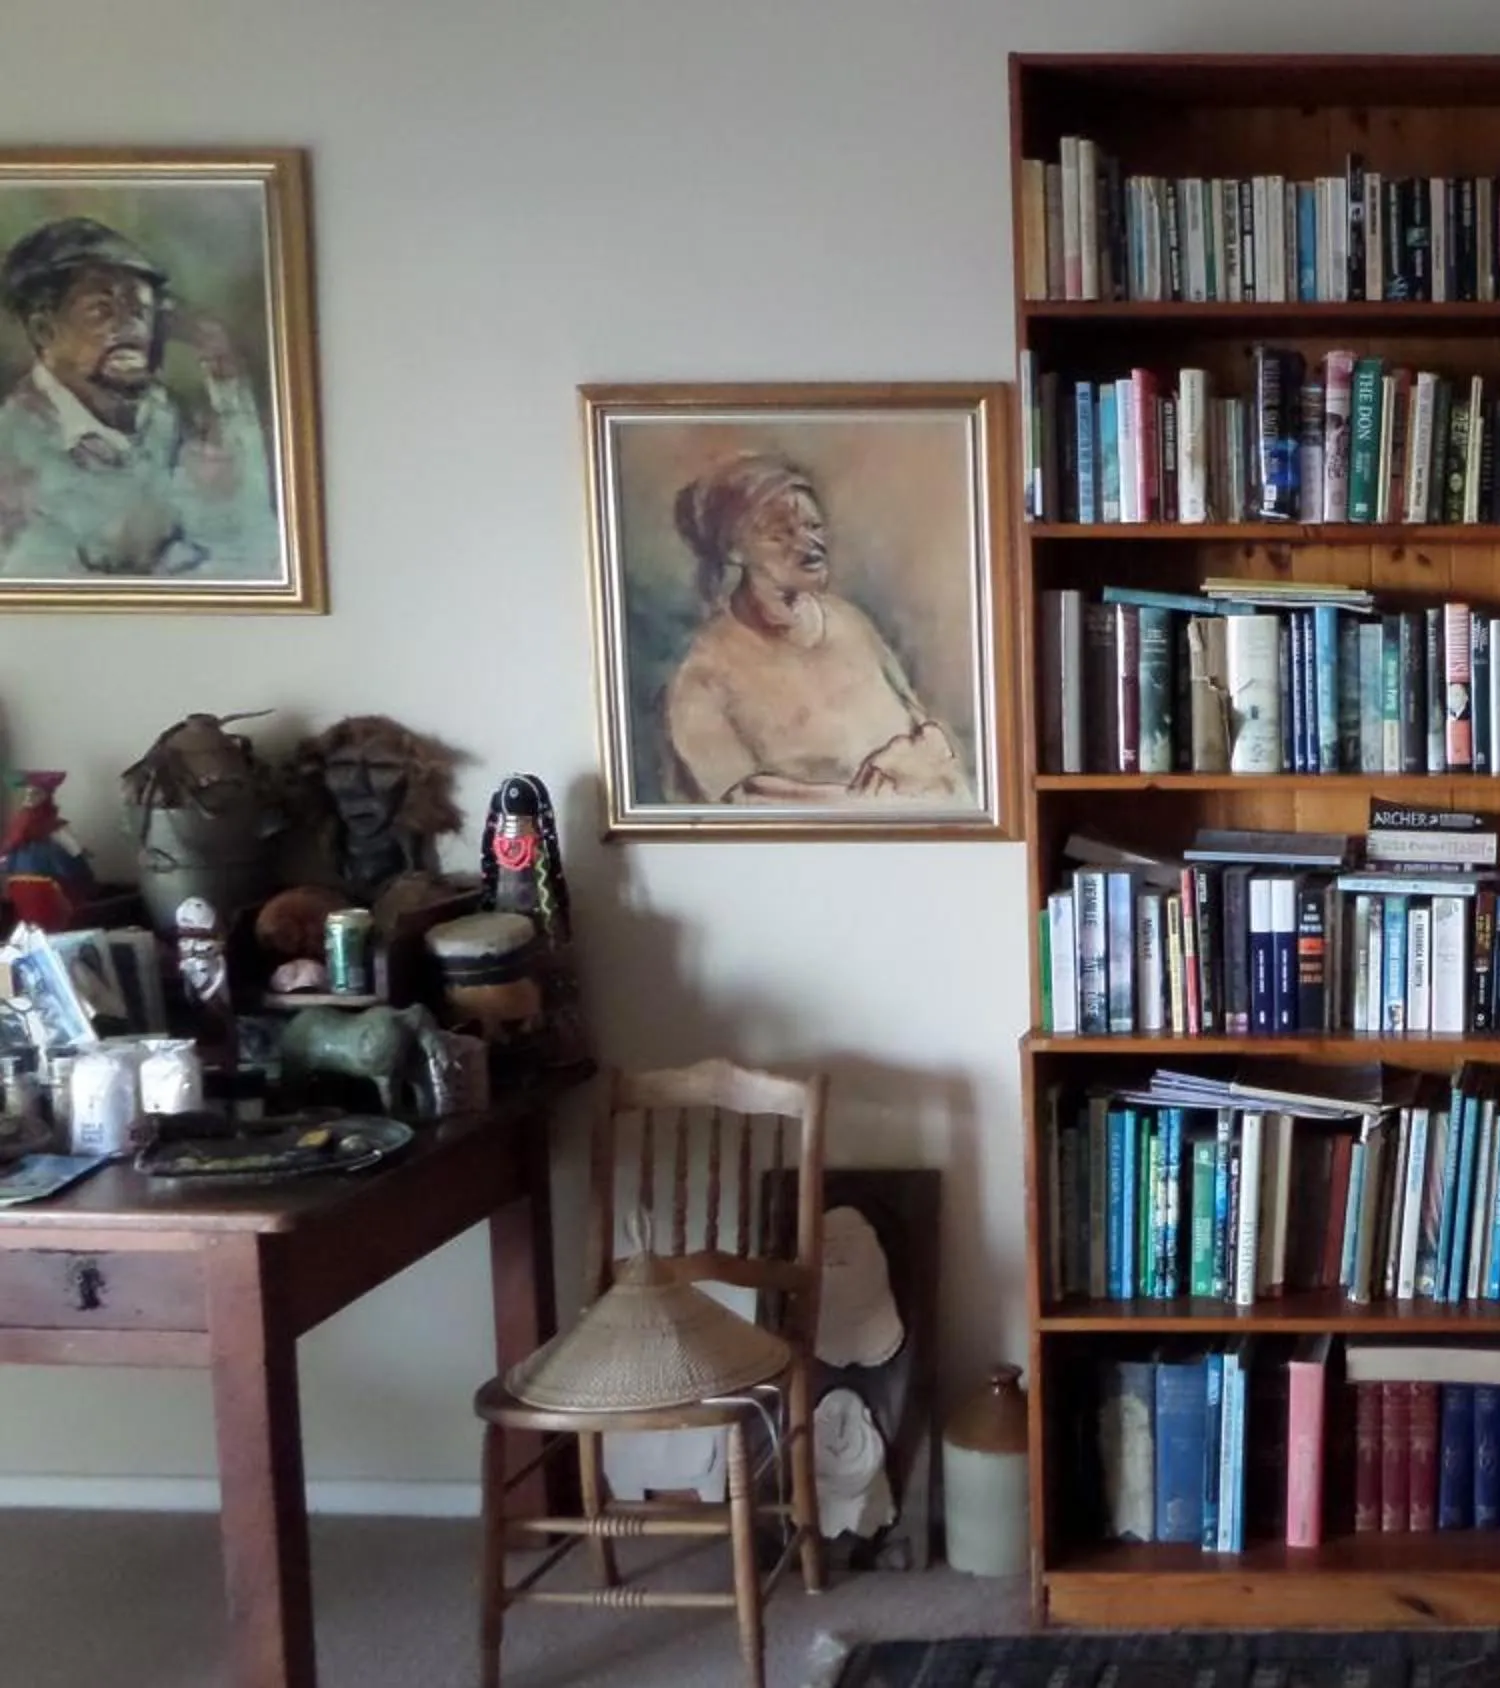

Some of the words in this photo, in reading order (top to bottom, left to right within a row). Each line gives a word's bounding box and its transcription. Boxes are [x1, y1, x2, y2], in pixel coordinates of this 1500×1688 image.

[1358, 373, 1376, 403] THE
[1356, 405, 1374, 441] DON
[1374, 811, 1427, 825] ARCHER
